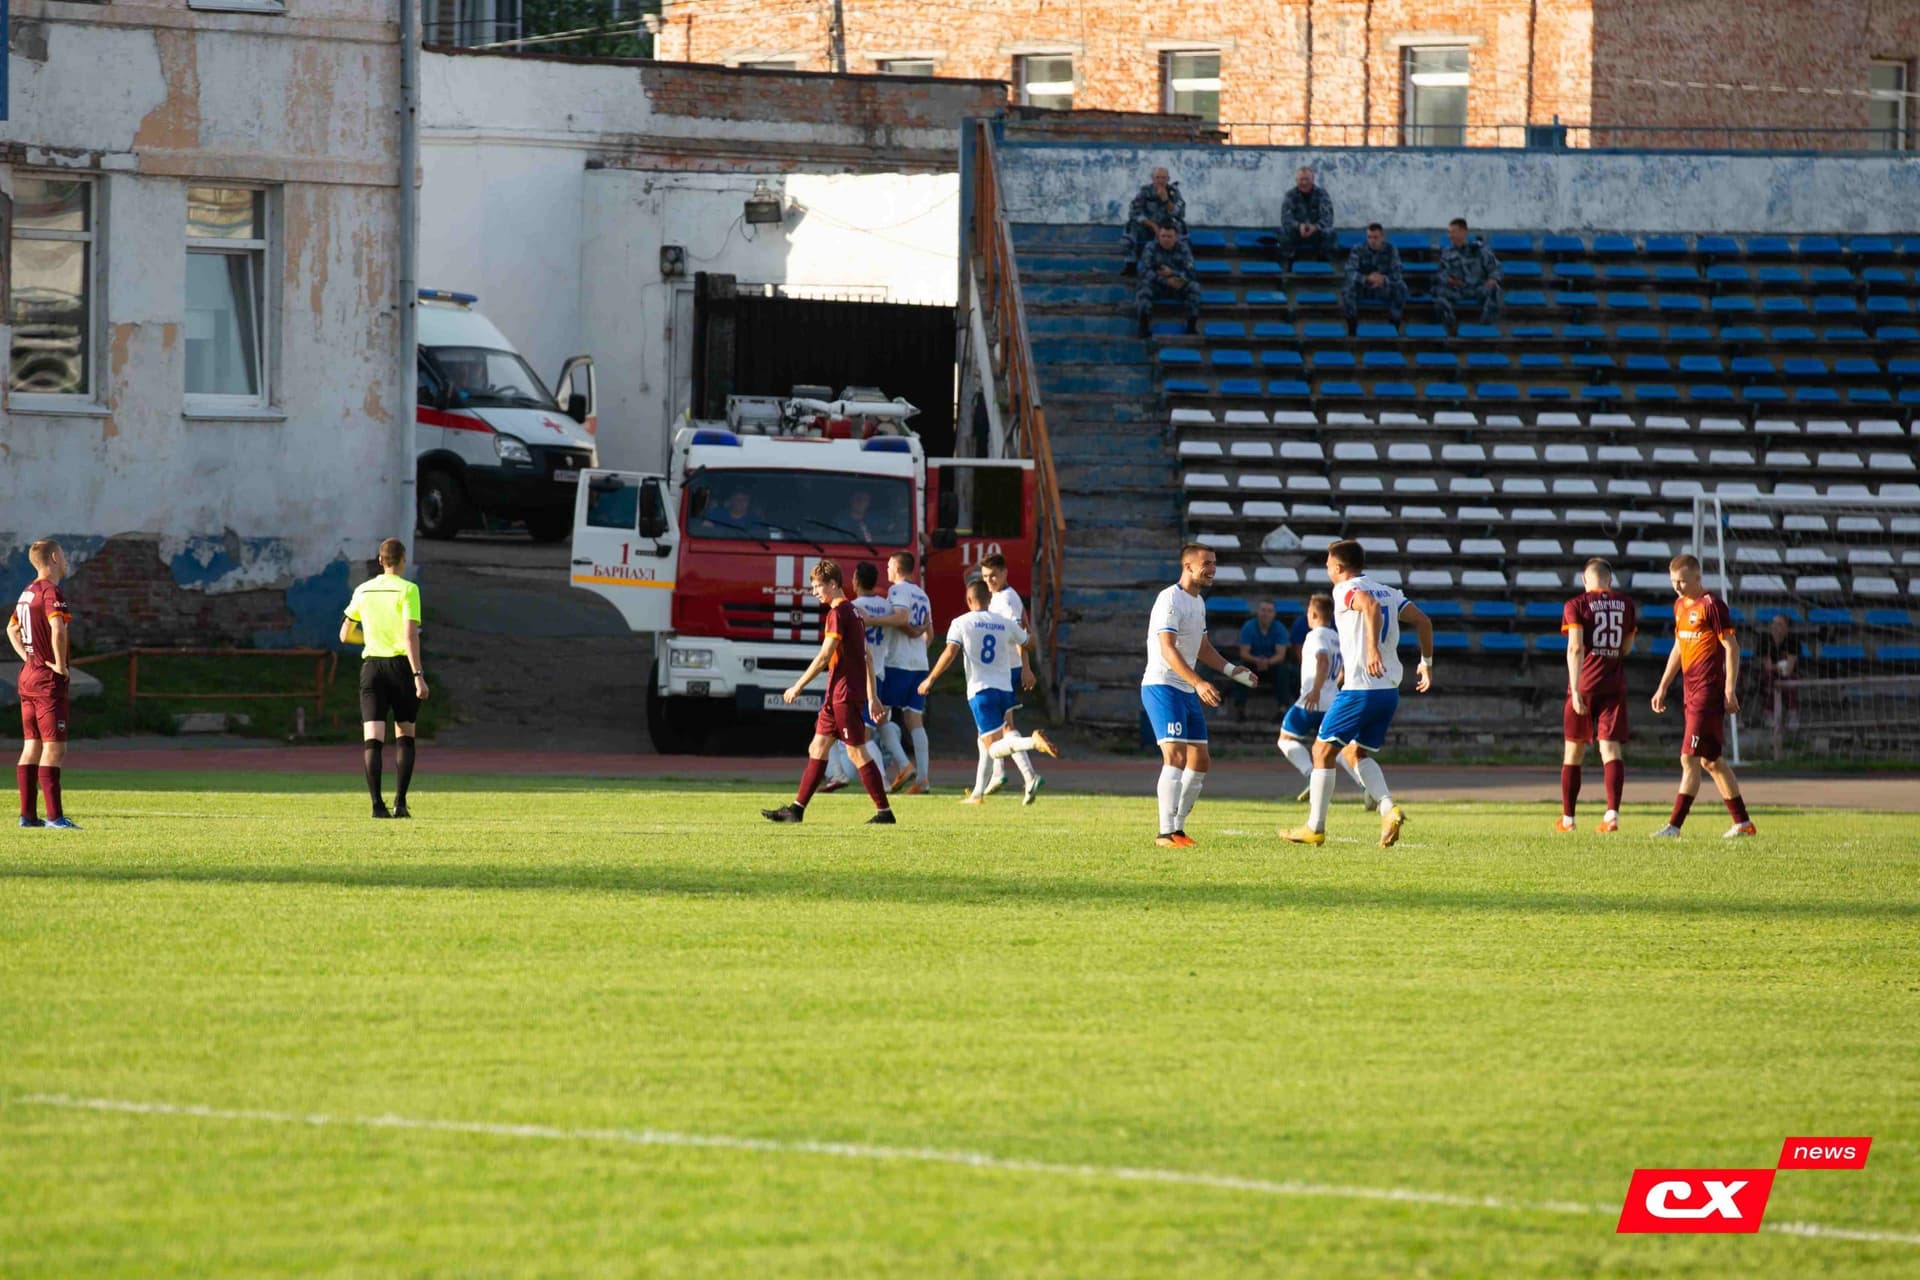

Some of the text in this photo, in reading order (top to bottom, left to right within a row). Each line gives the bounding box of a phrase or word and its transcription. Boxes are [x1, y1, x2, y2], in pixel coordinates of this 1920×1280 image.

[620, 543, 629, 565] 1
[594, 565, 655, 580] БАРНАУЛ
[1593, 611, 1623, 649] 25
[980, 634, 996, 664] 8
[1167, 721, 1182, 737] 49
